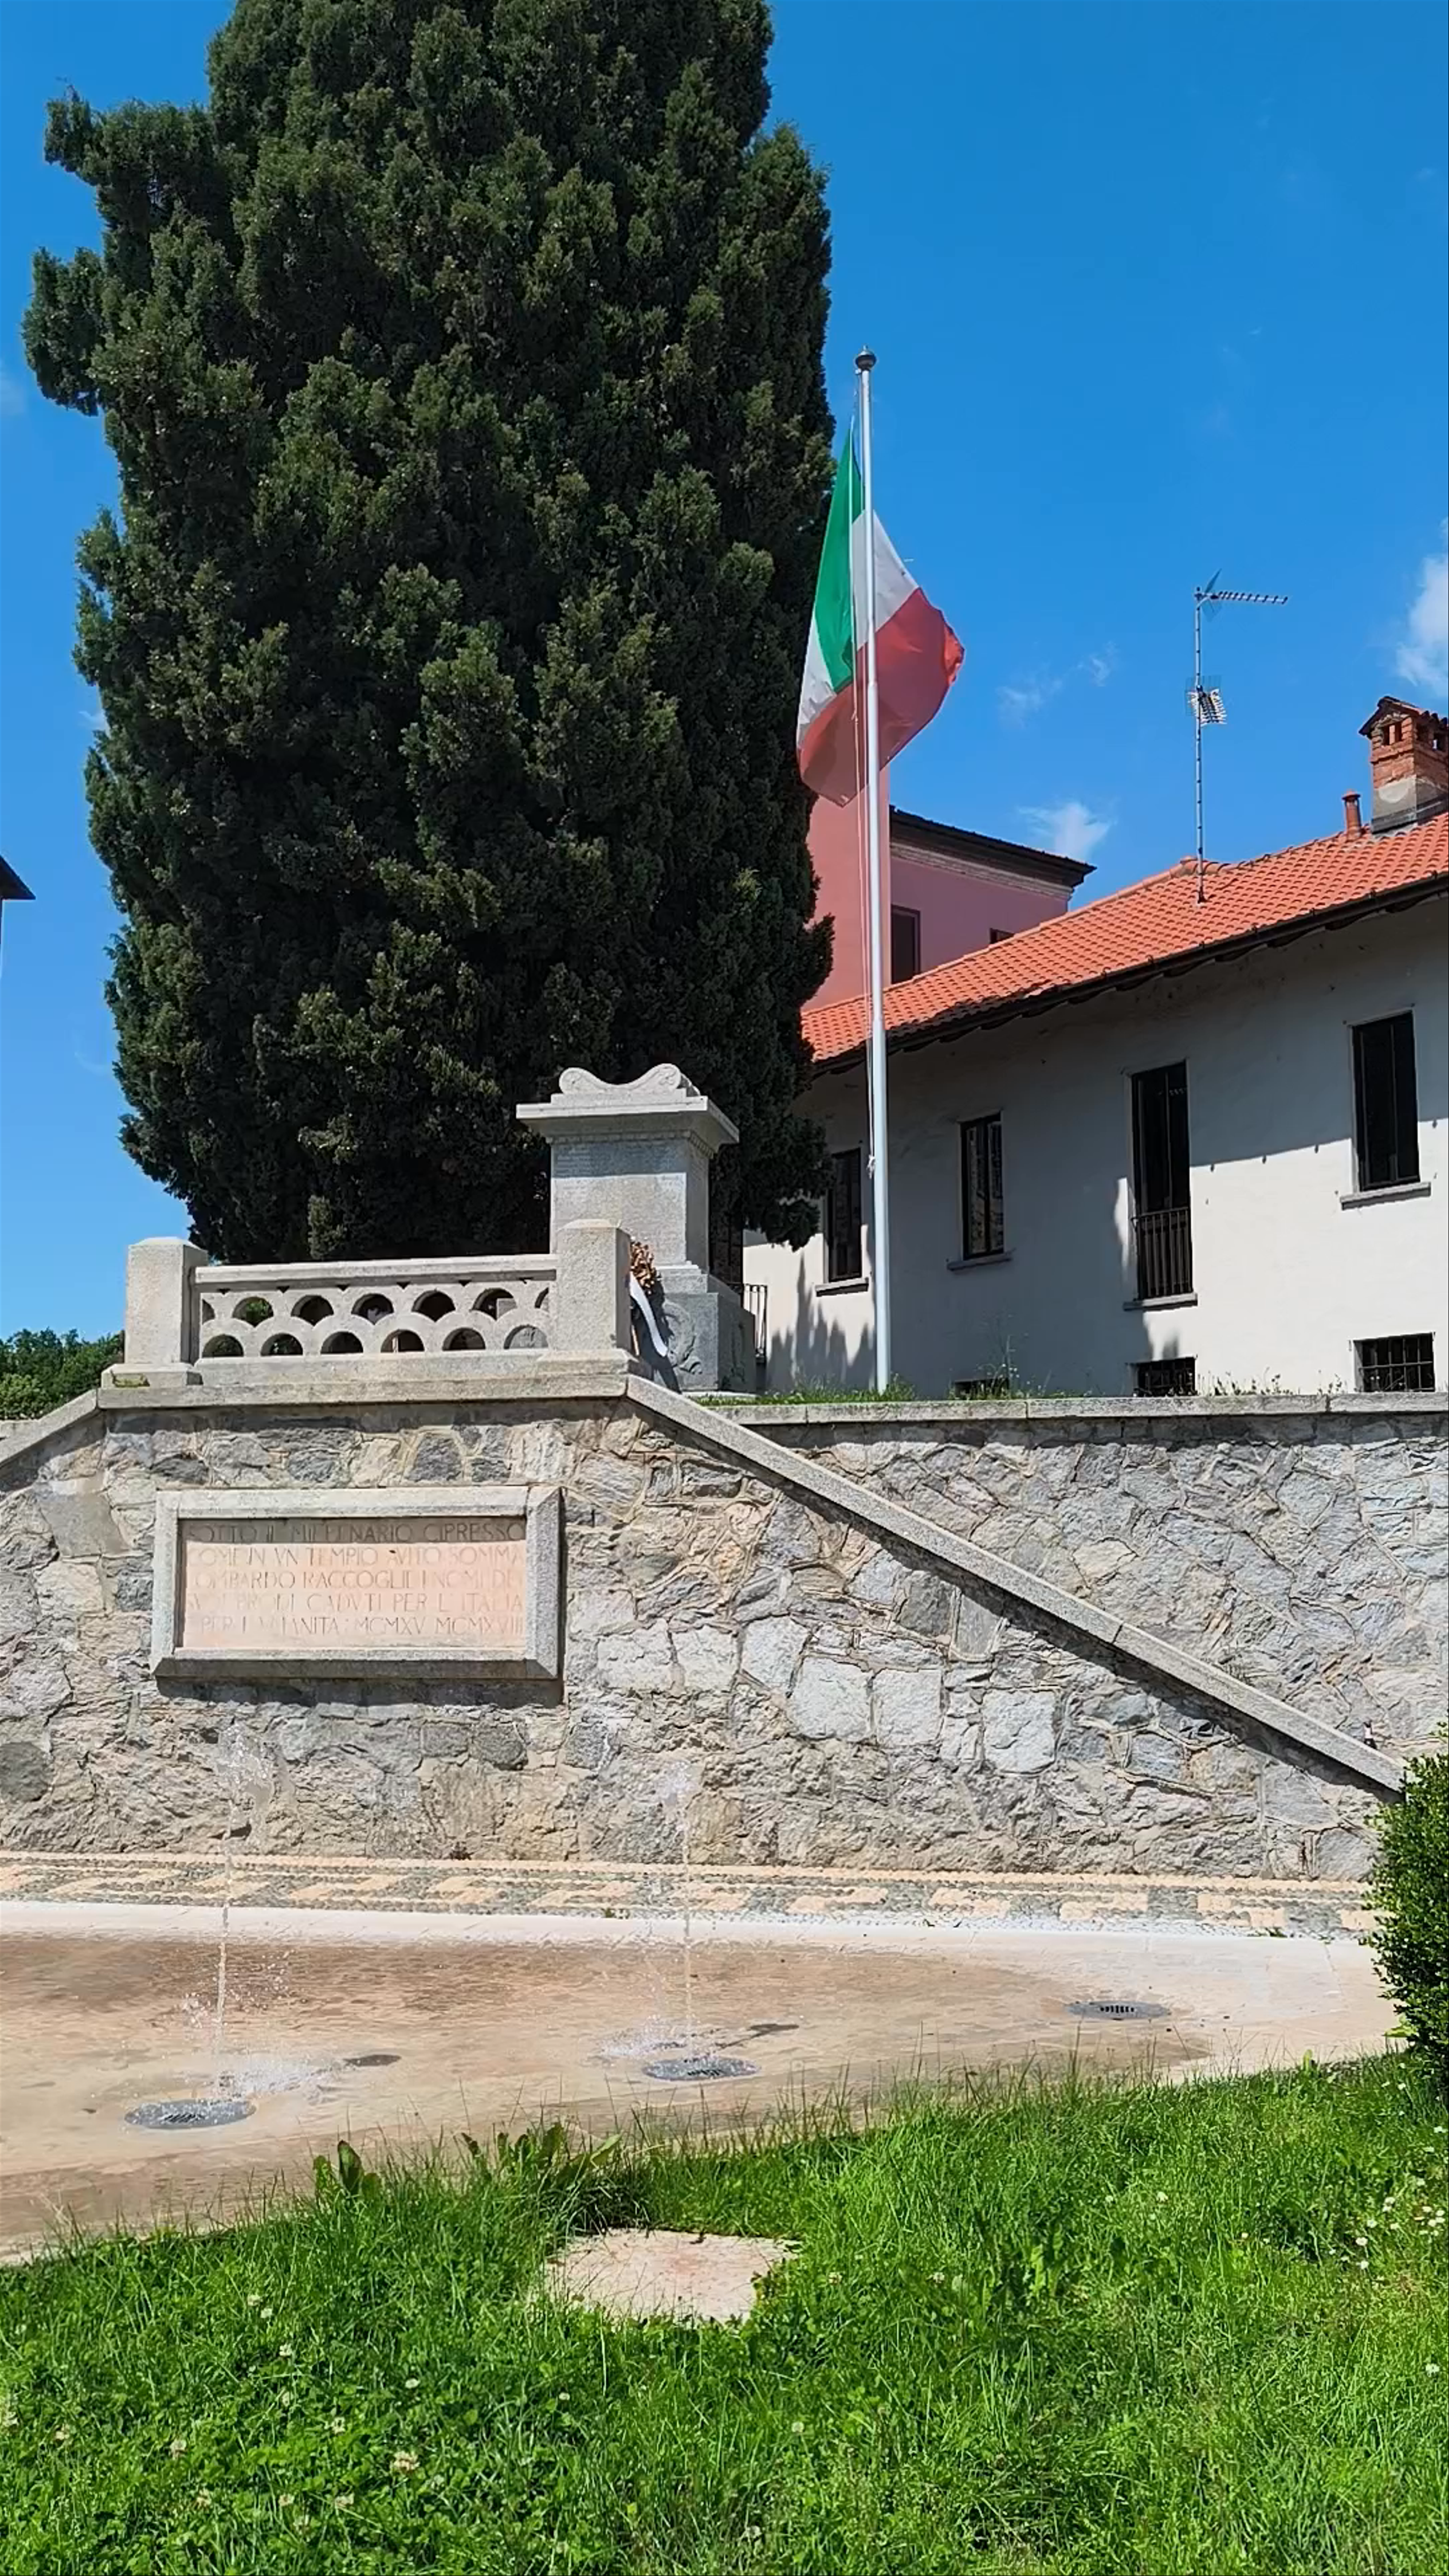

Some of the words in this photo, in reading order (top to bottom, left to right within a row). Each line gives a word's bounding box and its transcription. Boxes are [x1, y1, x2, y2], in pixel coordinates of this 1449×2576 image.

[423, 1522, 524, 1542] CIPRESSO
[248, 1547, 265, 1566] IN
[305, 1547, 378, 1566] TEMPIO
[189, 1571, 295, 1589] OMBARDO
[303, 1570, 413, 1589] RACCOGLIE
[392, 1593, 428, 1612] PER
